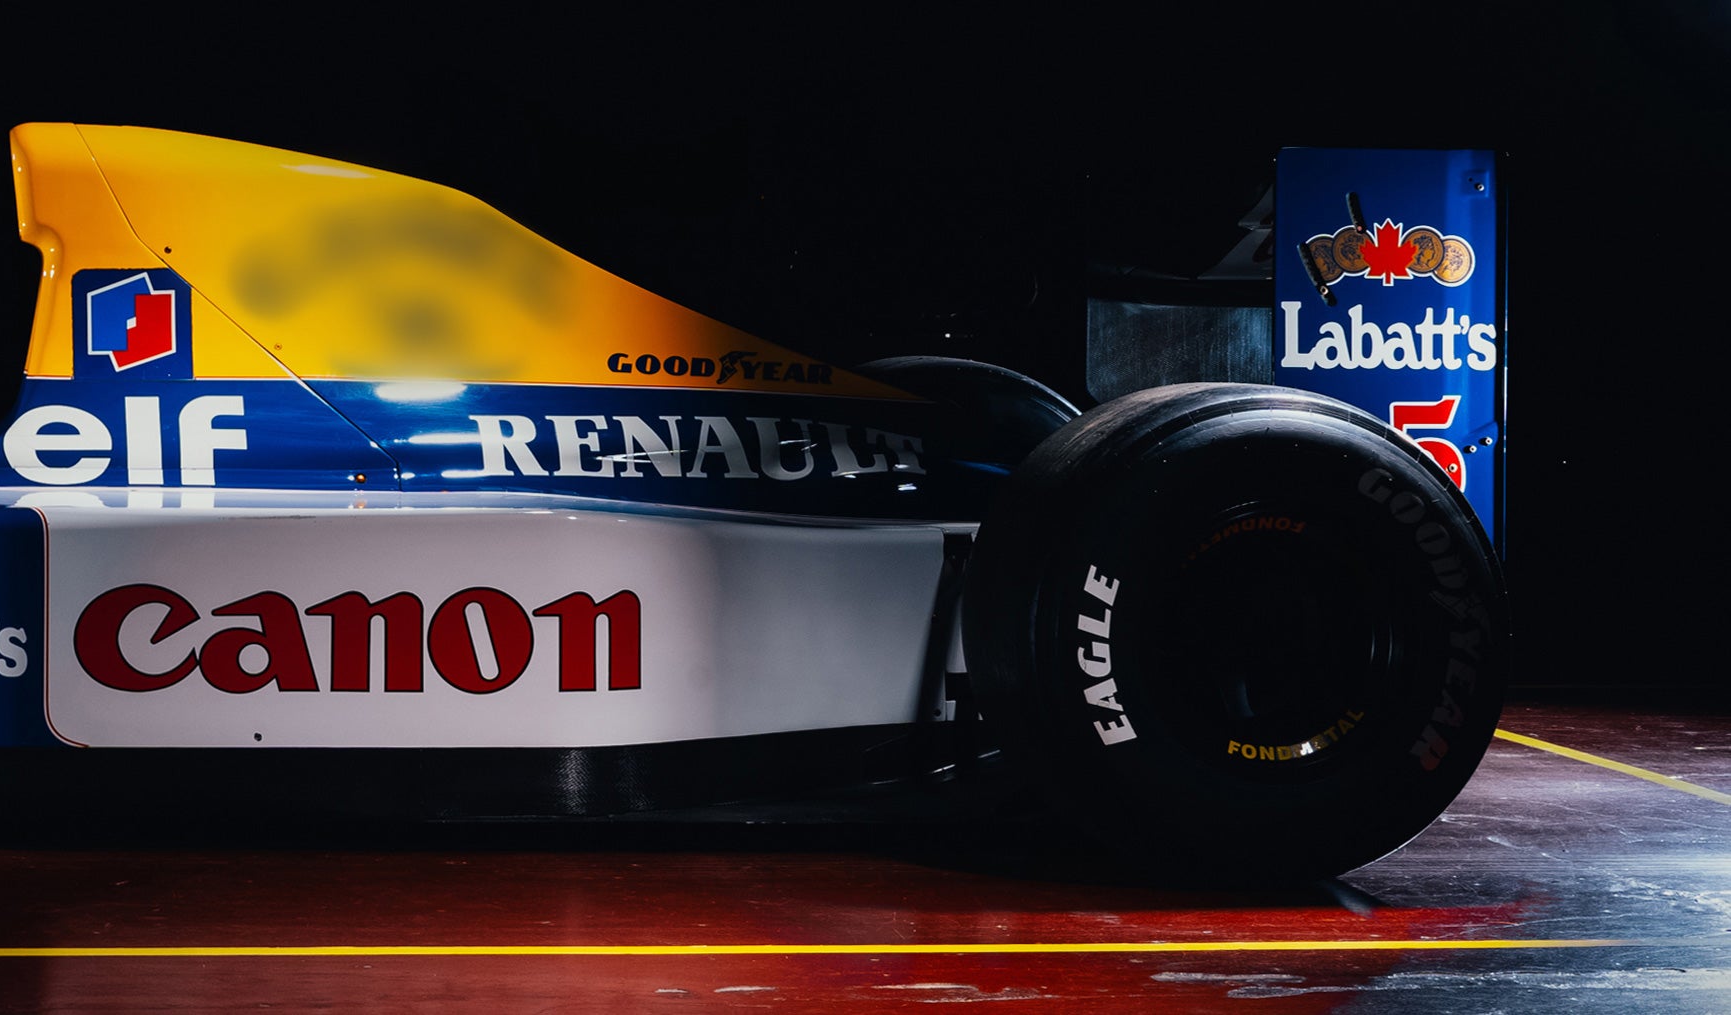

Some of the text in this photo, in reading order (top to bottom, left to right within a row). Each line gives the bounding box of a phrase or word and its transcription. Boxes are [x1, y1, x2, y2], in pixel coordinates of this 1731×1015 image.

[606, 352, 833, 385] GOODYEAR
[1280, 301, 1497, 371] Labatt's
[3, 394, 248, 486] elf
[468, 414, 928, 482] RENAULT
[1389, 394, 1467, 494] 5
[1077, 564, 1138, 746] EAGLE
